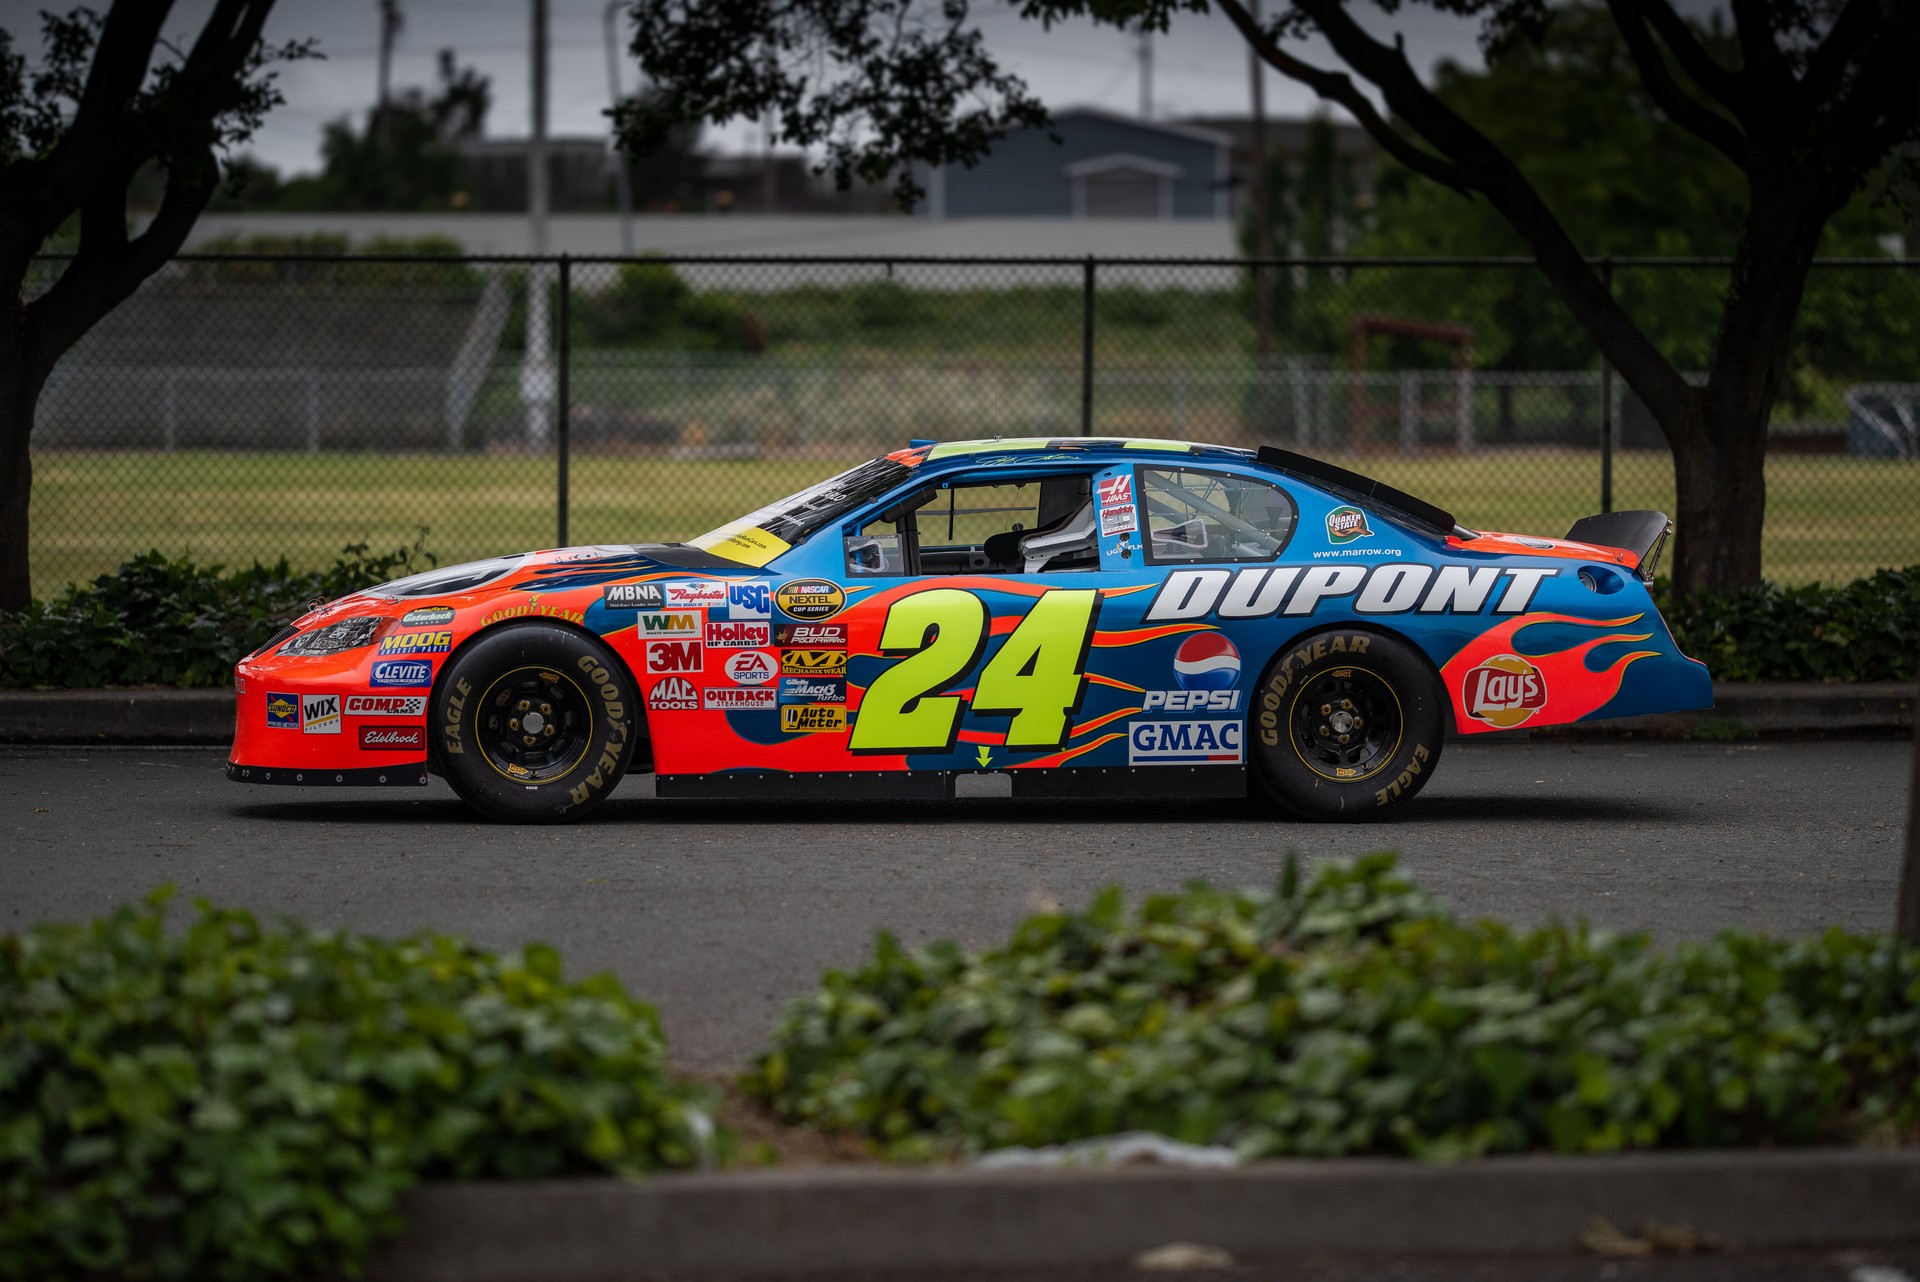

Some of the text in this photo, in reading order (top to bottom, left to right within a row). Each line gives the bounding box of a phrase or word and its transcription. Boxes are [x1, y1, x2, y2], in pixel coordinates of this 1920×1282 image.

[1106, 493, 1129, 503] HAAS
[1102, 505, 1134, 518] Hendrick
[1328, 513, 1362, 526] QUAKER
[1334, 520, 1358, 531] STATE
[1312, 548, 1402, 558] www.marrow.org
[606, 585, 662, 601] MBNA
[667, 588, 725, 602] Raybestos
[801, 585, 829, 594] NASCAR
[1142, 562, 1562, 623] DUPONT
[729, 585, 770, 614] USG
[789, 595, 831, 604] NEXTEL
[402, 611, 455, 622] Gatorback
[642, 614, 695, 630] WM
[706, 623, 769, 646] Holley
[793, 627, 841, 637] BUD
[380, 631, 452, 650] MOOG
[381, 645, 449, 655] CHASSIS PARTS
[648, 641, 702, 672] 3M
[734, 653, 769, 671] EA
[375, 663, 427, 679] CLEVITE
[733, 671, 770, 680] SPORTS
[781, 666, 847, 674] MECHANIX WEAR
[847, 588, 1100, 752] 24
[649, 677, 698, 700] MAC
[795, 684, 837, 696] MACH3
[1472, 670, 1538, 713] Lay's
[706, 690, 774, 702] OUTBACK
[1142, 689, 1241, 712] PEPSI
[269, 704, 296, 713] SUNOCO
[304, 696, 338, 721] WIX
[348, 698, 405, 711] COMP
[649, 701, 698, 710] TOOLS
[445, 677, 473, 754] EAGLE
[800, 708, 835, 718] Auto
[305, 718, 339, 732] FILTERS
[797, 718, 843, 728] Meter
[364, 730, 419, 744] Edelbrock
[1132, 723, 1239, 751] GMAC
[1375, 742, 1430, 807] EAGLE
